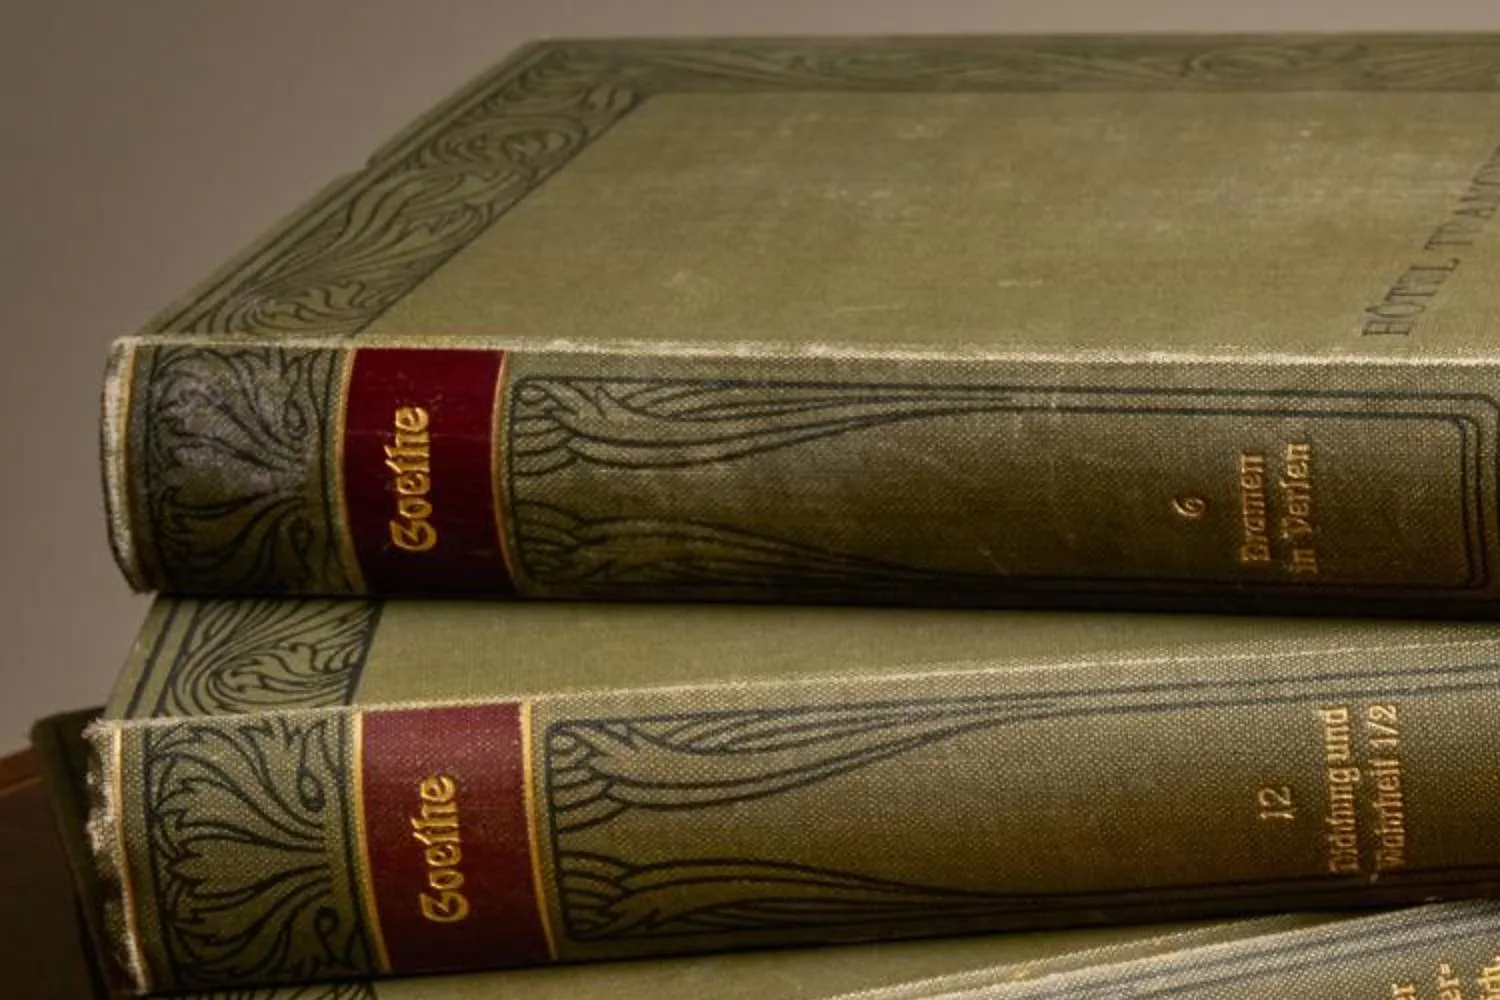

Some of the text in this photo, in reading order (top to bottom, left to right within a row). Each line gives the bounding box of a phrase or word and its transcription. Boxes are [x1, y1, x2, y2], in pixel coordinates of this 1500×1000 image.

[384, 407, 437, 550] Goethe
[1172, 497, 1206, 518] 6
[1320, 708, 1350, 762] und
[1367, 705, 1400, 747] 1/2
[1257, 786, 1294, 819] 12
[411, 776, 470, 923] Goethe
